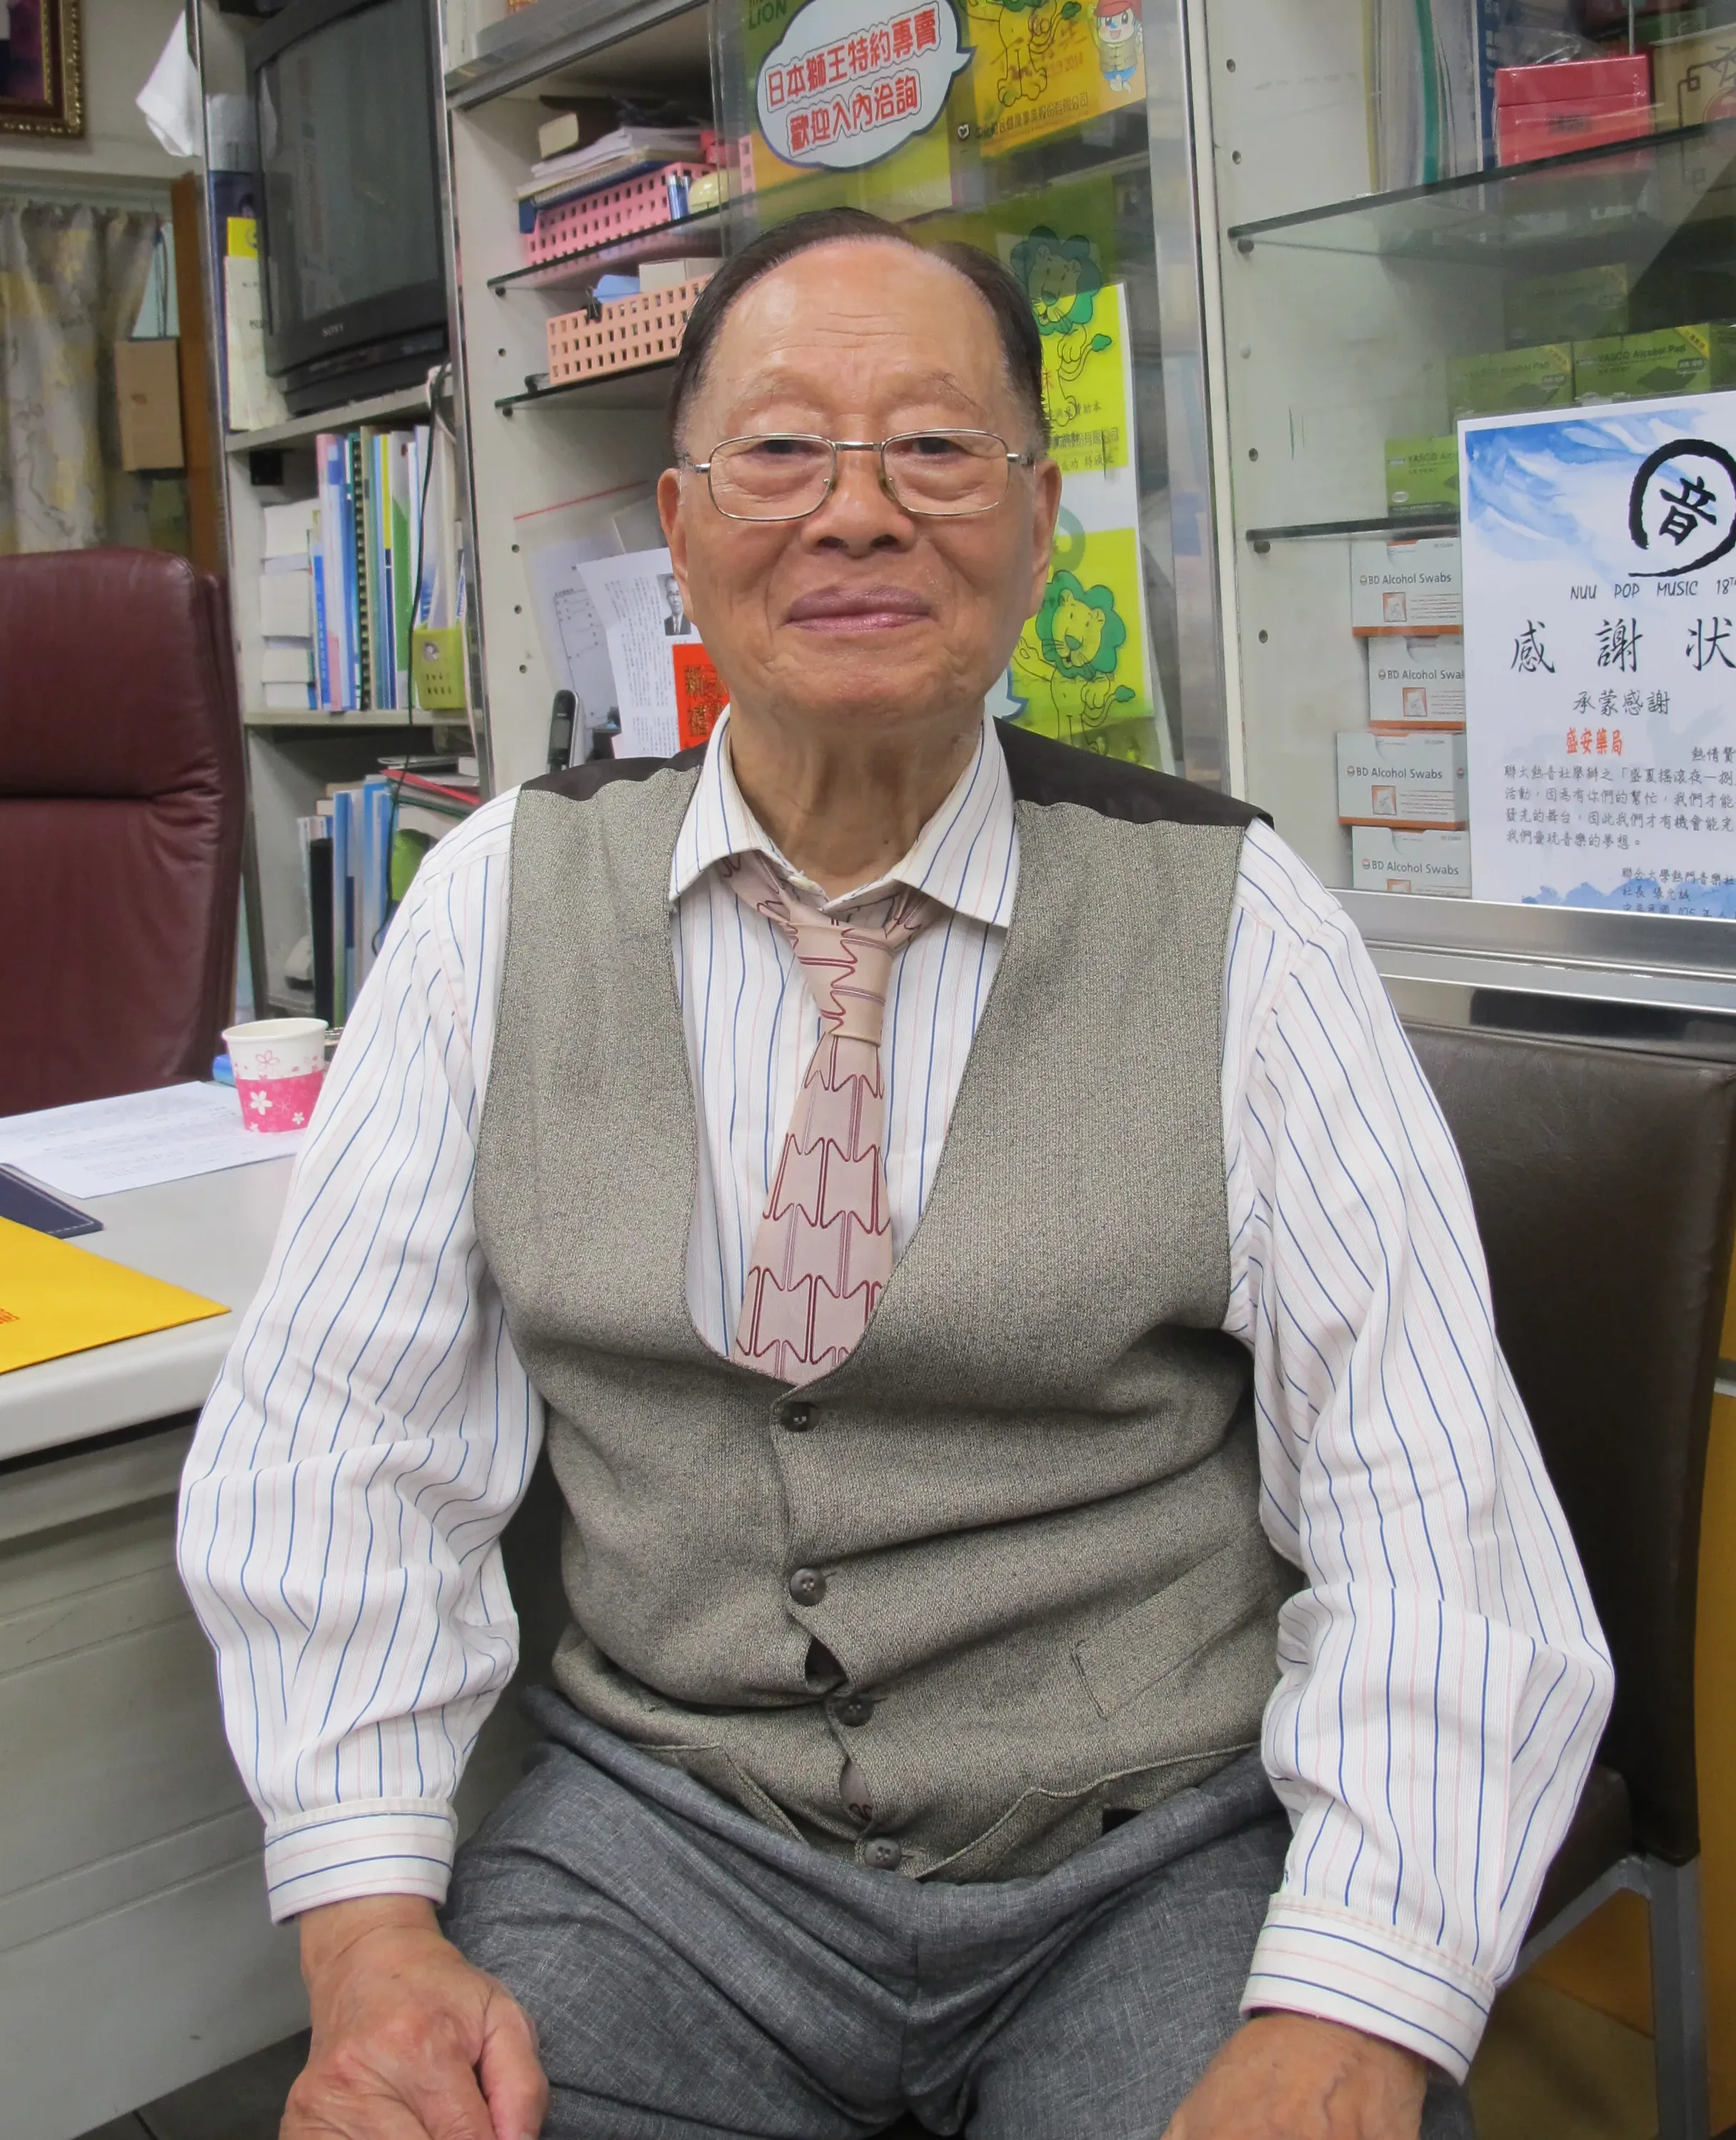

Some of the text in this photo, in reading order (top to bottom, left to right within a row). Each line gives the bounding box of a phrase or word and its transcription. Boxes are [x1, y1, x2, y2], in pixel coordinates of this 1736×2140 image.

[748, 0, 787, 31] LION
[767, 8, 937, 107] 日本獅王特約專賣
[789, 75, 918, 152] 歡迎入內洽詢
[1368, 572, 1452, 585] BD Alcohol Swabs
[1570, 584, 1597, 601] NUU
[1613, 582, 1640, 599] POP
[1656, 580, 1698, 597] MUSIC
[1387, 669, 1463, 680] BD Alcohol Swa
[1572, 688, 1671, 717] 承蒙感謝
[1565, 727, 1623, 757] 盛安藥局
[1356, 766, 1443, 779] BD Alcohol Swabs
[1371, 860, 1459, 875] BD Alcohol Swabs
